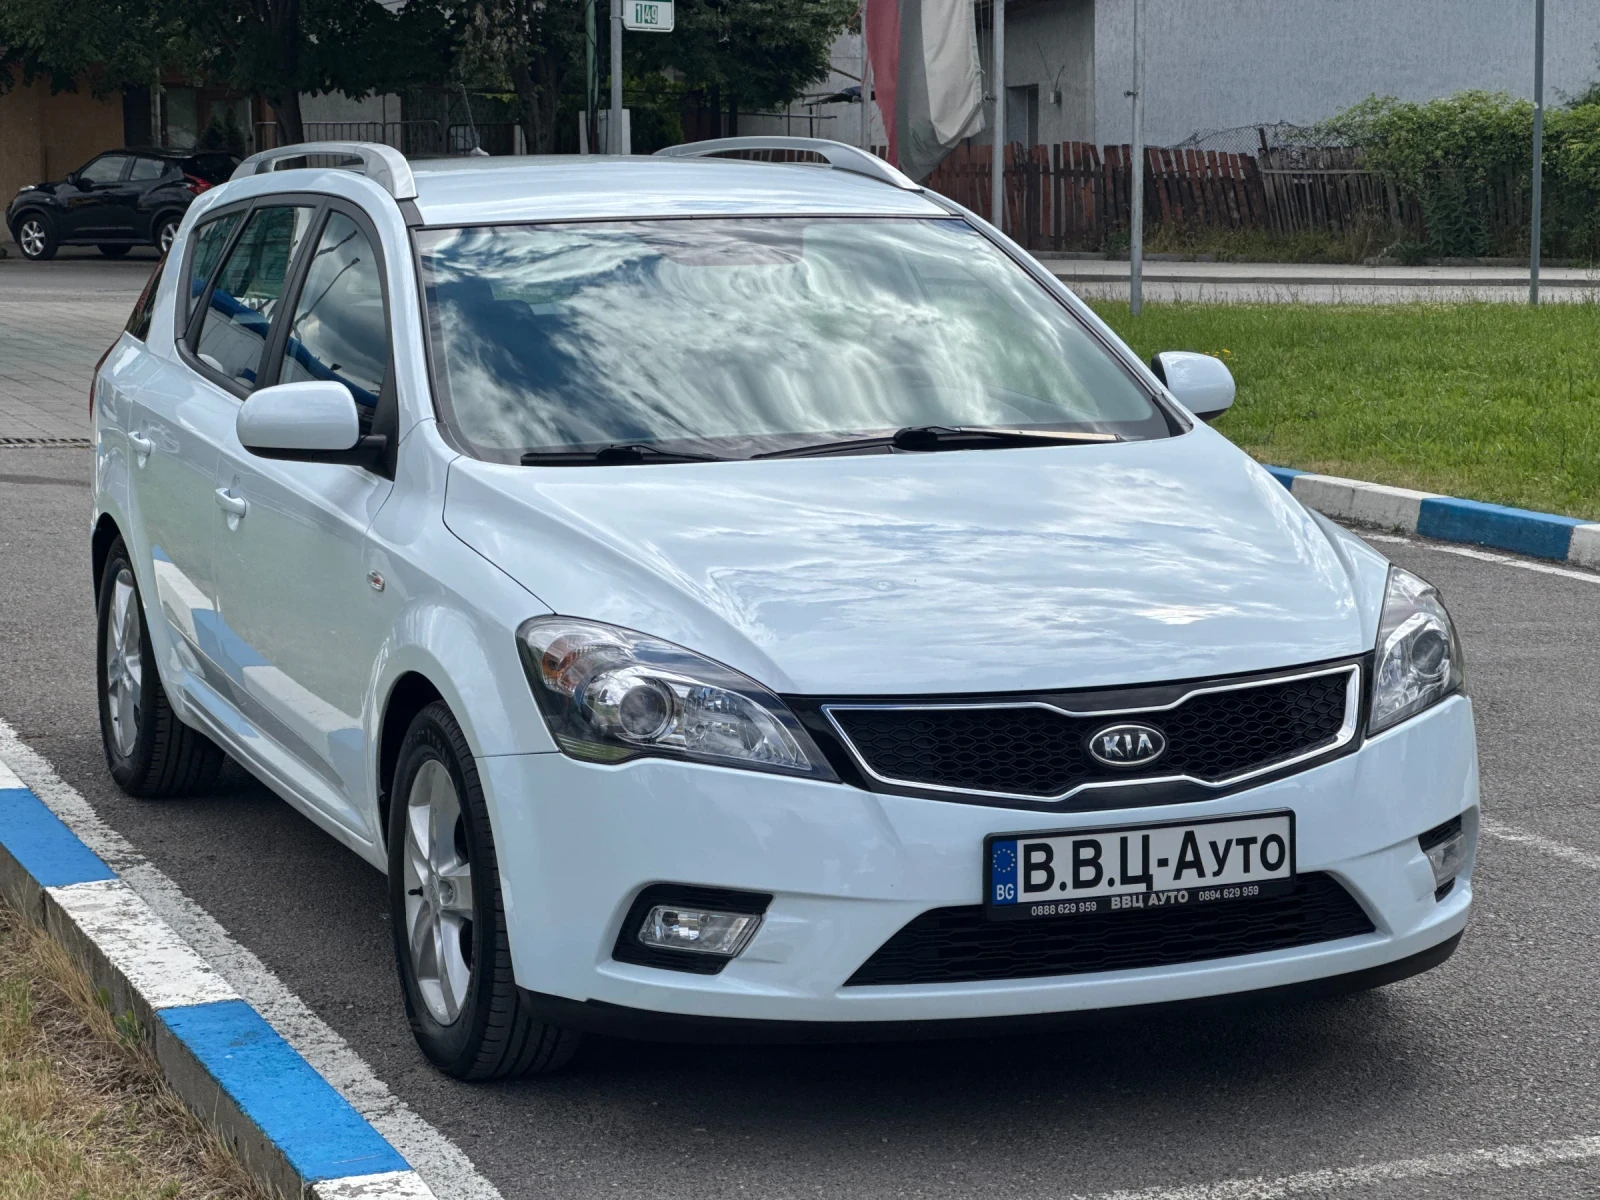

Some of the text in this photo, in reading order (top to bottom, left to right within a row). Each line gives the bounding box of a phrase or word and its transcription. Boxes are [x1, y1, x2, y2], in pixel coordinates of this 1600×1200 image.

[636, 3, 658, 24] 149
[1102, 732, 1155, 758] KIA
[1023, 830, 1286, 893] В.В.Ц-Ауто
[996, 883, 1015, 900] BG
[1031, 885, 1259, 916] 0888 629 959 ВВЦ АУТО 0894 629 959
